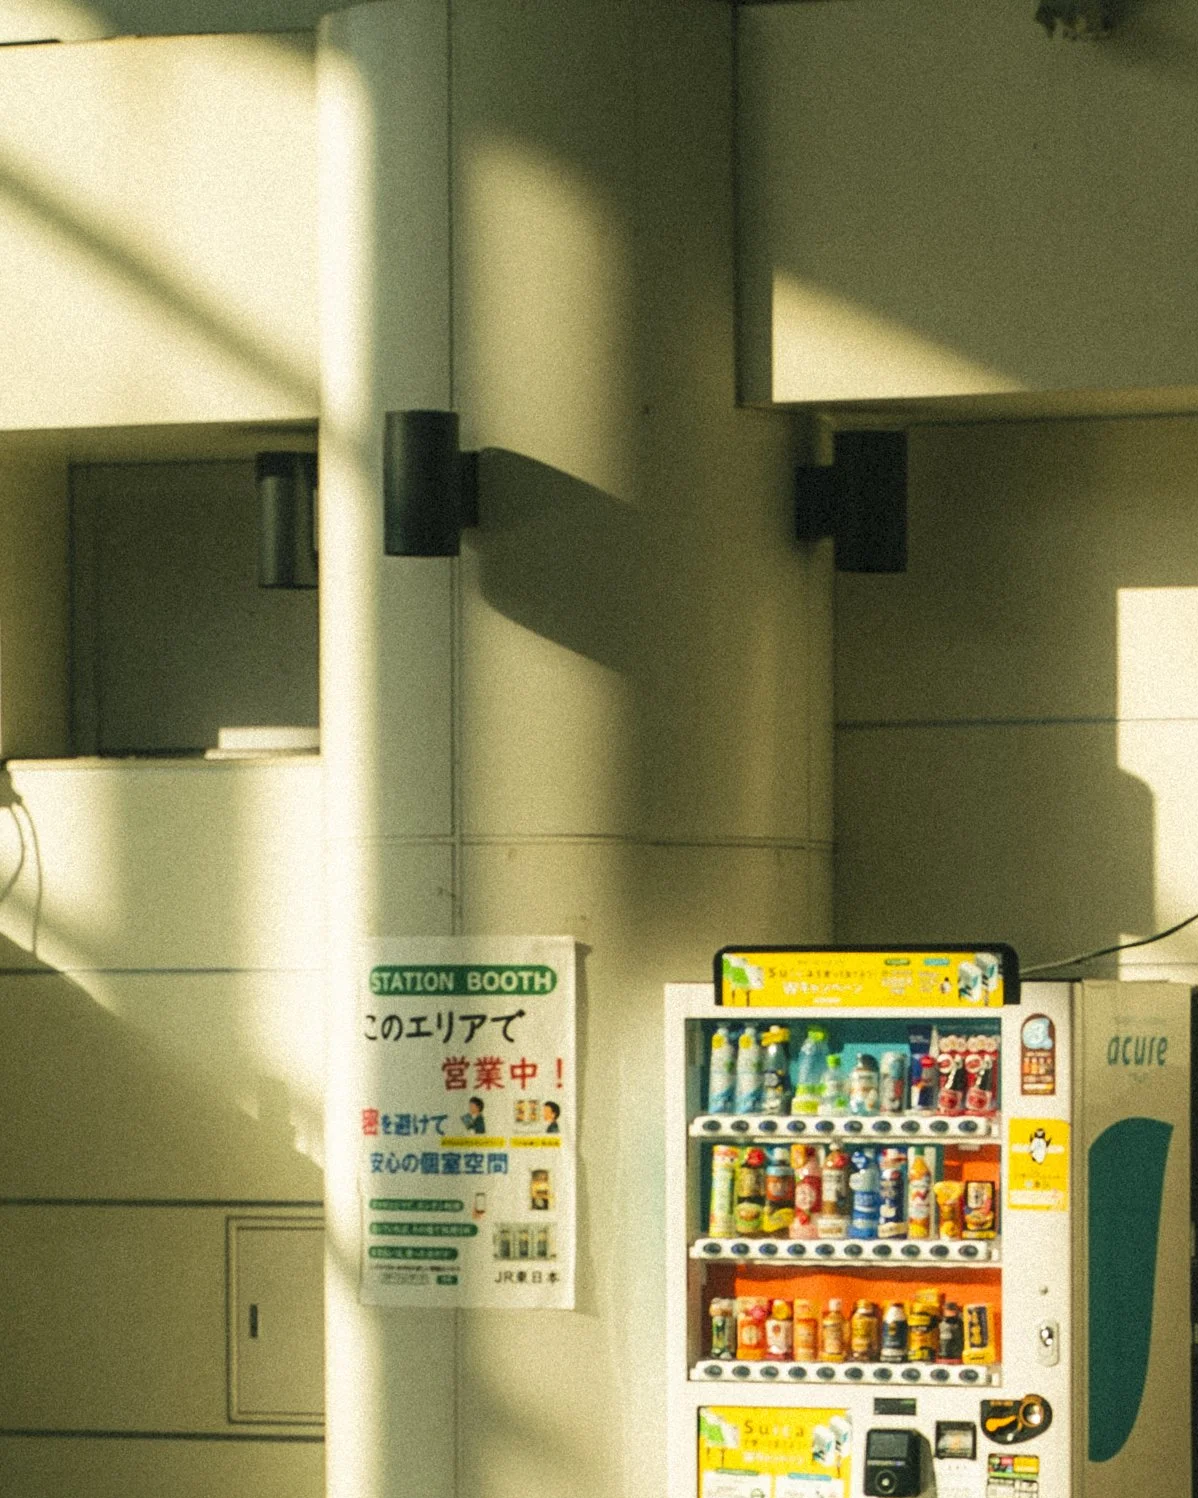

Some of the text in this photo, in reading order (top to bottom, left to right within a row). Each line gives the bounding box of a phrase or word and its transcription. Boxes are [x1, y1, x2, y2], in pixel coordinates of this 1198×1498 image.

[370, 971, 552, 992] STATION BOOTH
[364, 1009, 526, 1043] このエリアで
[1106, 1036, 1168, 1067] acure
[370, 1152, 509, 1175] 安心の個室空間
